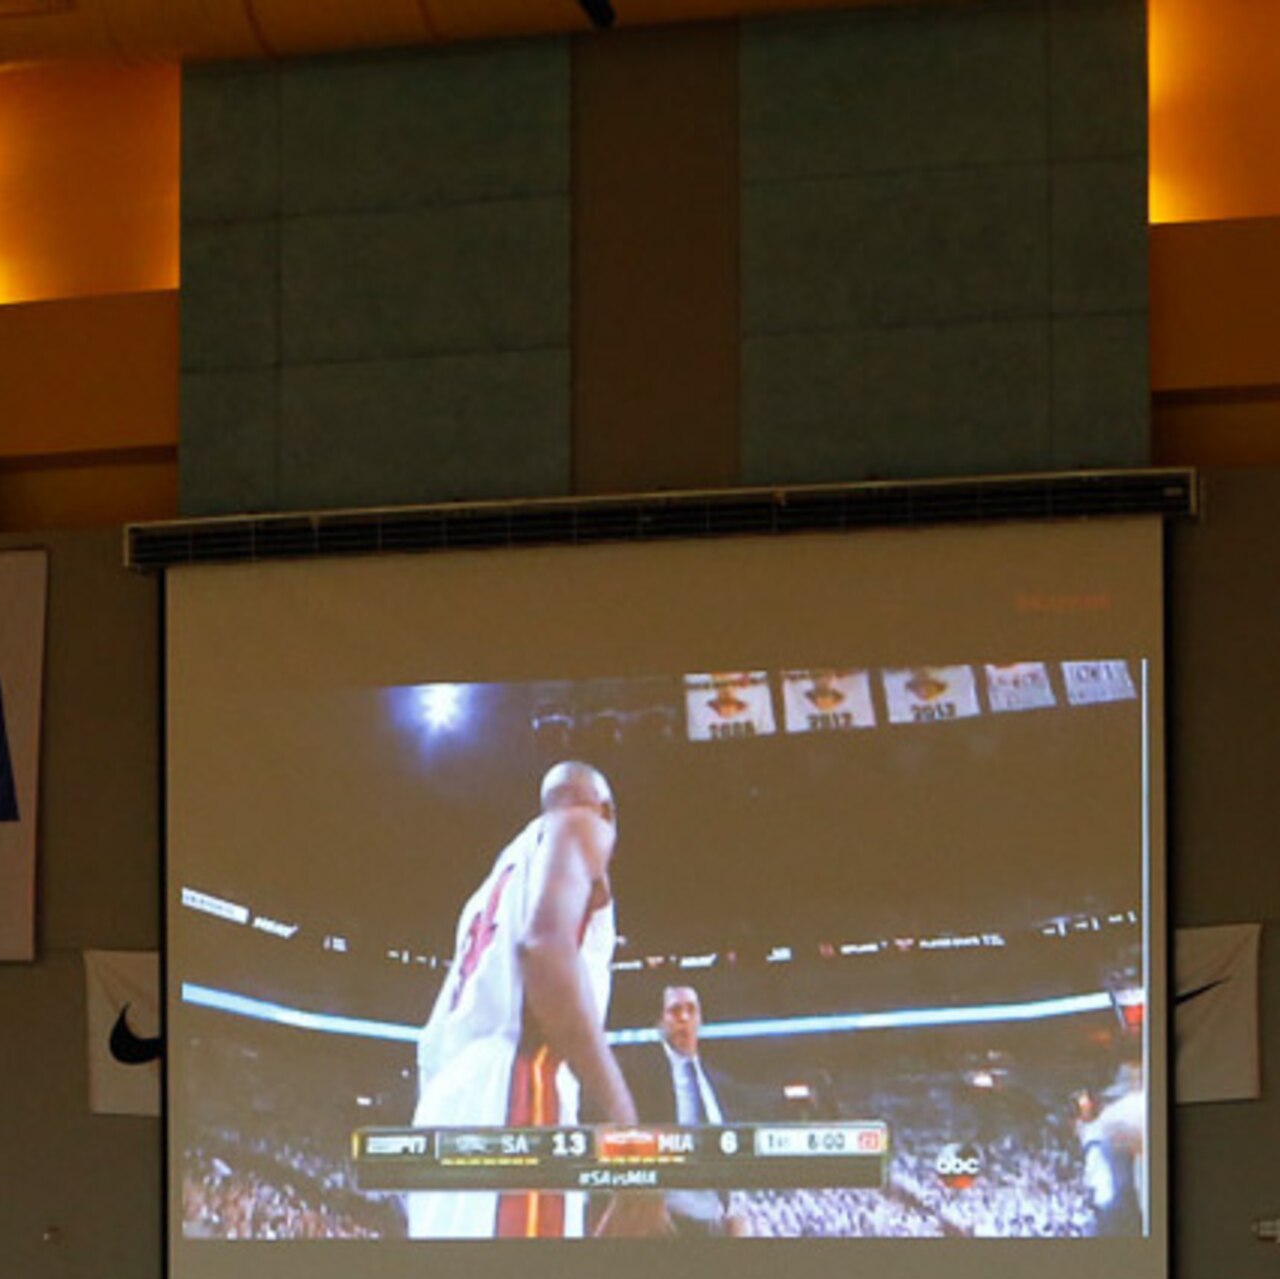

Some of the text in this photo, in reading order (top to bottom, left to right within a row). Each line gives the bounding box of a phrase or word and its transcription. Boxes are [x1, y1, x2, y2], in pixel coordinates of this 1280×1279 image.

[500, 1133, 530, 1154] SA
[551, 1131, 587, 1156] 13
[657, 1133, 694, 1153] MIA
